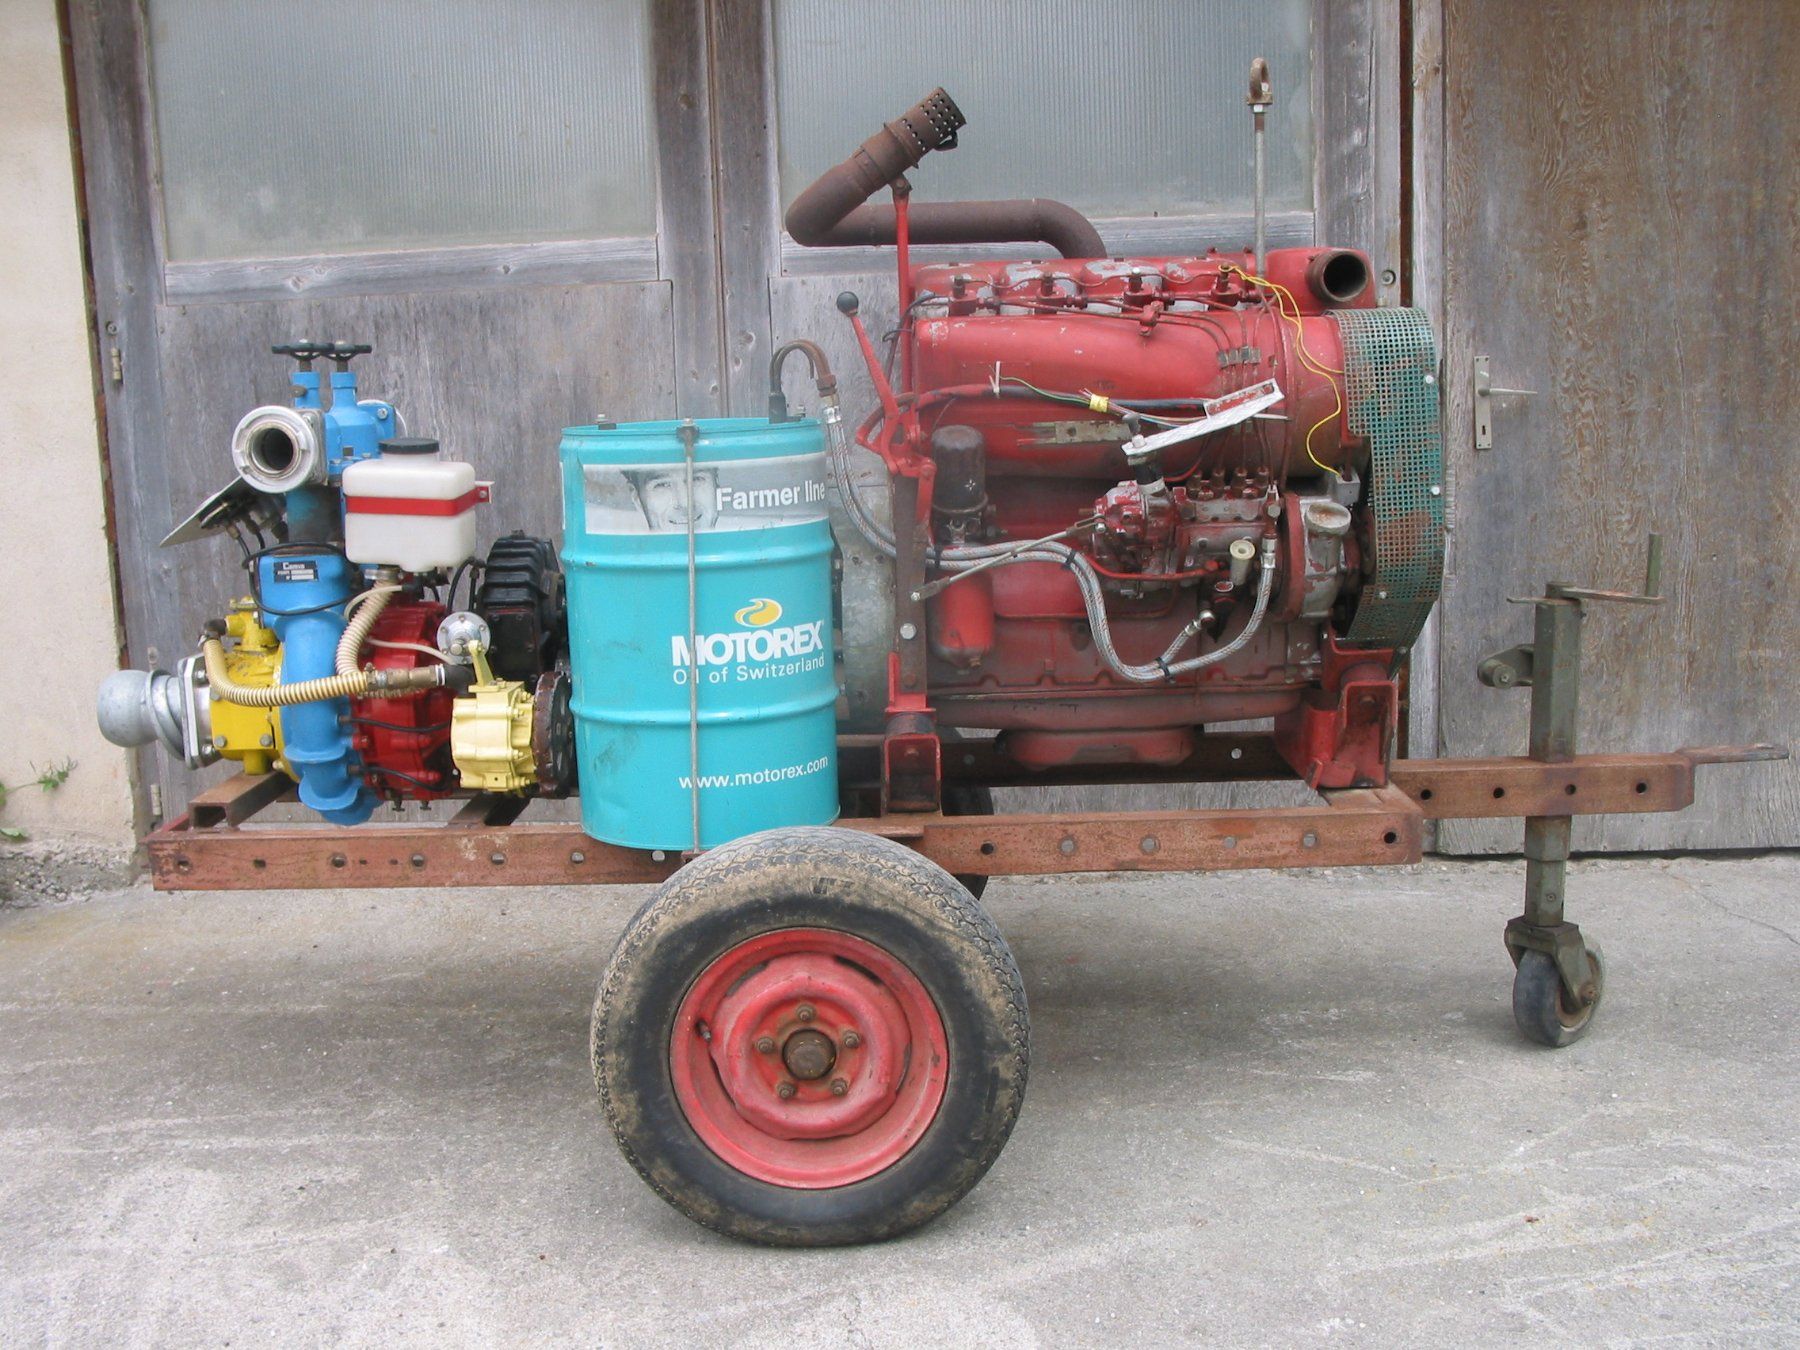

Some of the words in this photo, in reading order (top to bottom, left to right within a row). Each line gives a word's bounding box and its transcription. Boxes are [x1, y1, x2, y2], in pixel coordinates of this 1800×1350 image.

[716, 486, 800, 511] Farmer
[805, 480, 825, 502] line
[671, 620, 824, 666] MOTOREX
[673, 668, 699, 685] Ol
[709, 666, 729, 684] of
[736, 652, 825, 682] Switzerland
[678, 755, 829, 789] www.motorex.com
